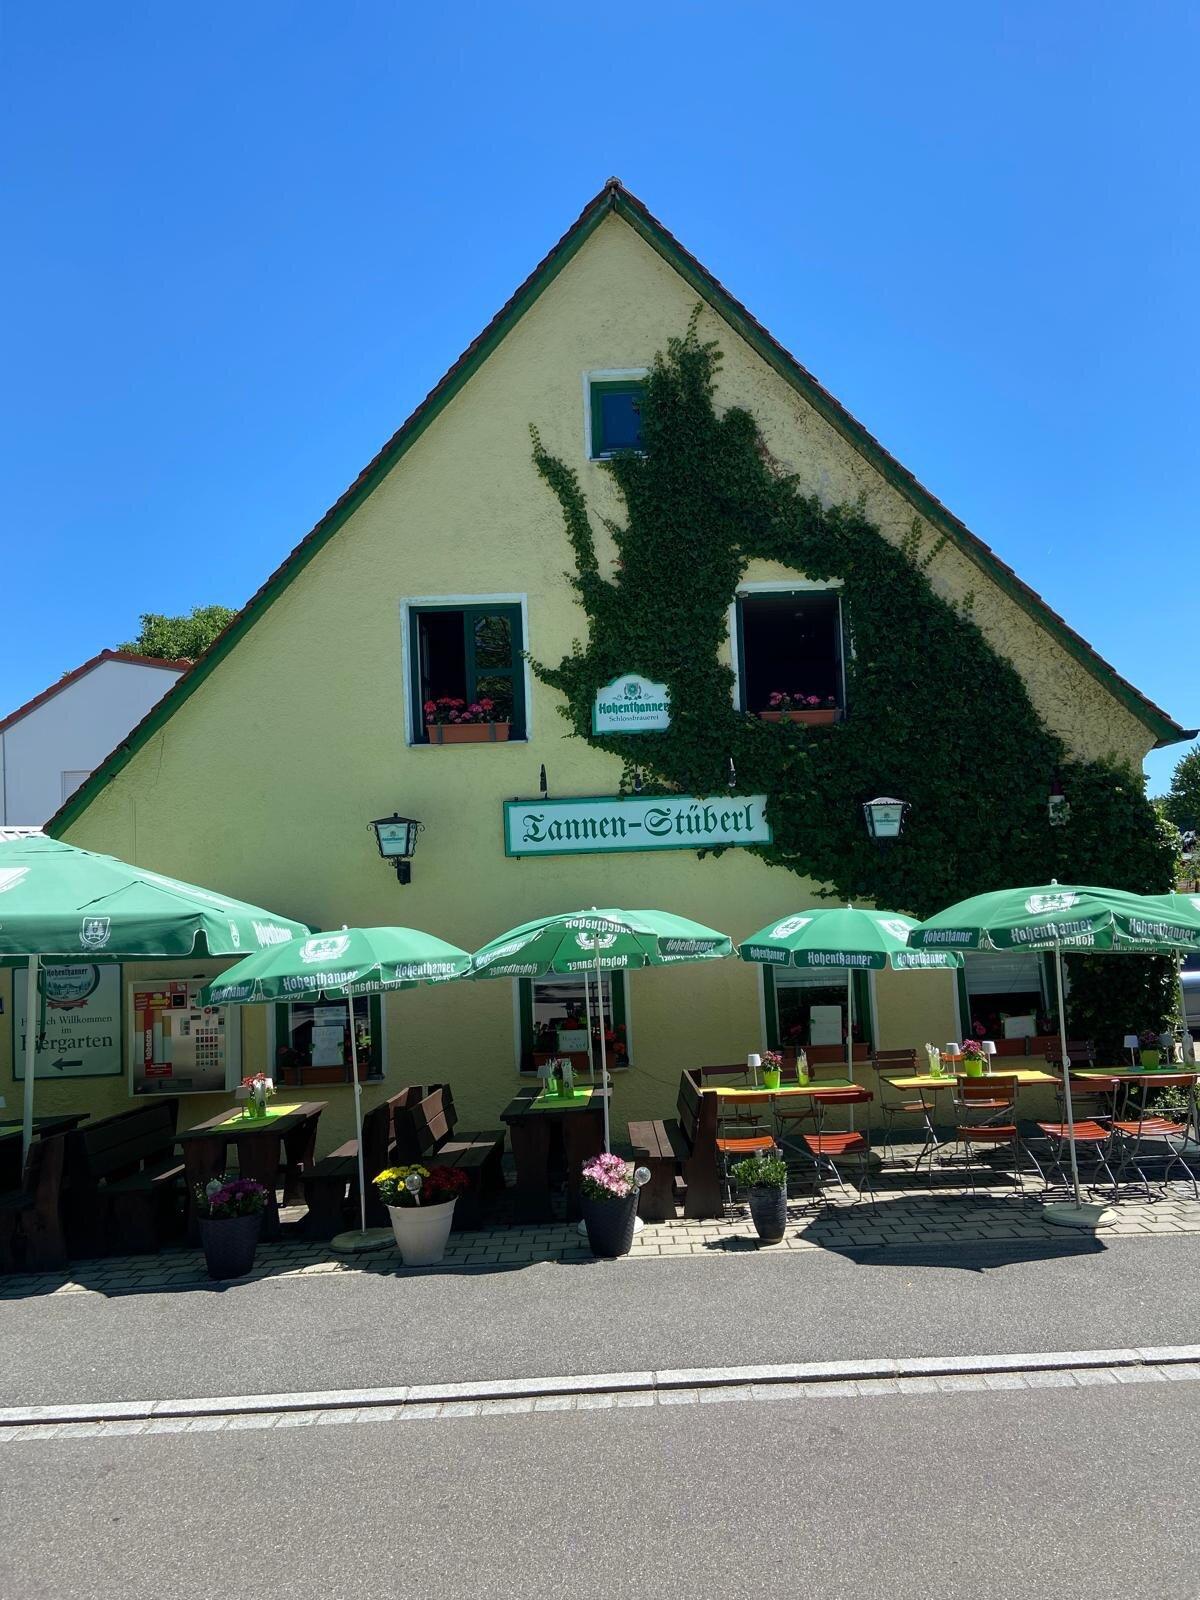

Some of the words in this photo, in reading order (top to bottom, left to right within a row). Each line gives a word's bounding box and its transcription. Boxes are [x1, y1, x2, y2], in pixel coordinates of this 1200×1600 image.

[599, 702, 669, 715] Hohenthanner
[609, 714, 659, 722] Schlossbrauerei
[522, 803, 754, 843] Tannen-Stüberl
[1010, 917, 1093, 943] Hohenthanner
[1128, 918, 1196, 942] Hohenthanner
[807, 951, 873, 968] Hohenthanner
[897, 952, 948, 968] Hohenthanner
[395, 961, 456, 979] Hohenthanner
[283, 969, 360, 992] Hohenthanner
[58, 1015, 113, 1025] Willkommen
[61, 1026, 72, 1034] im
